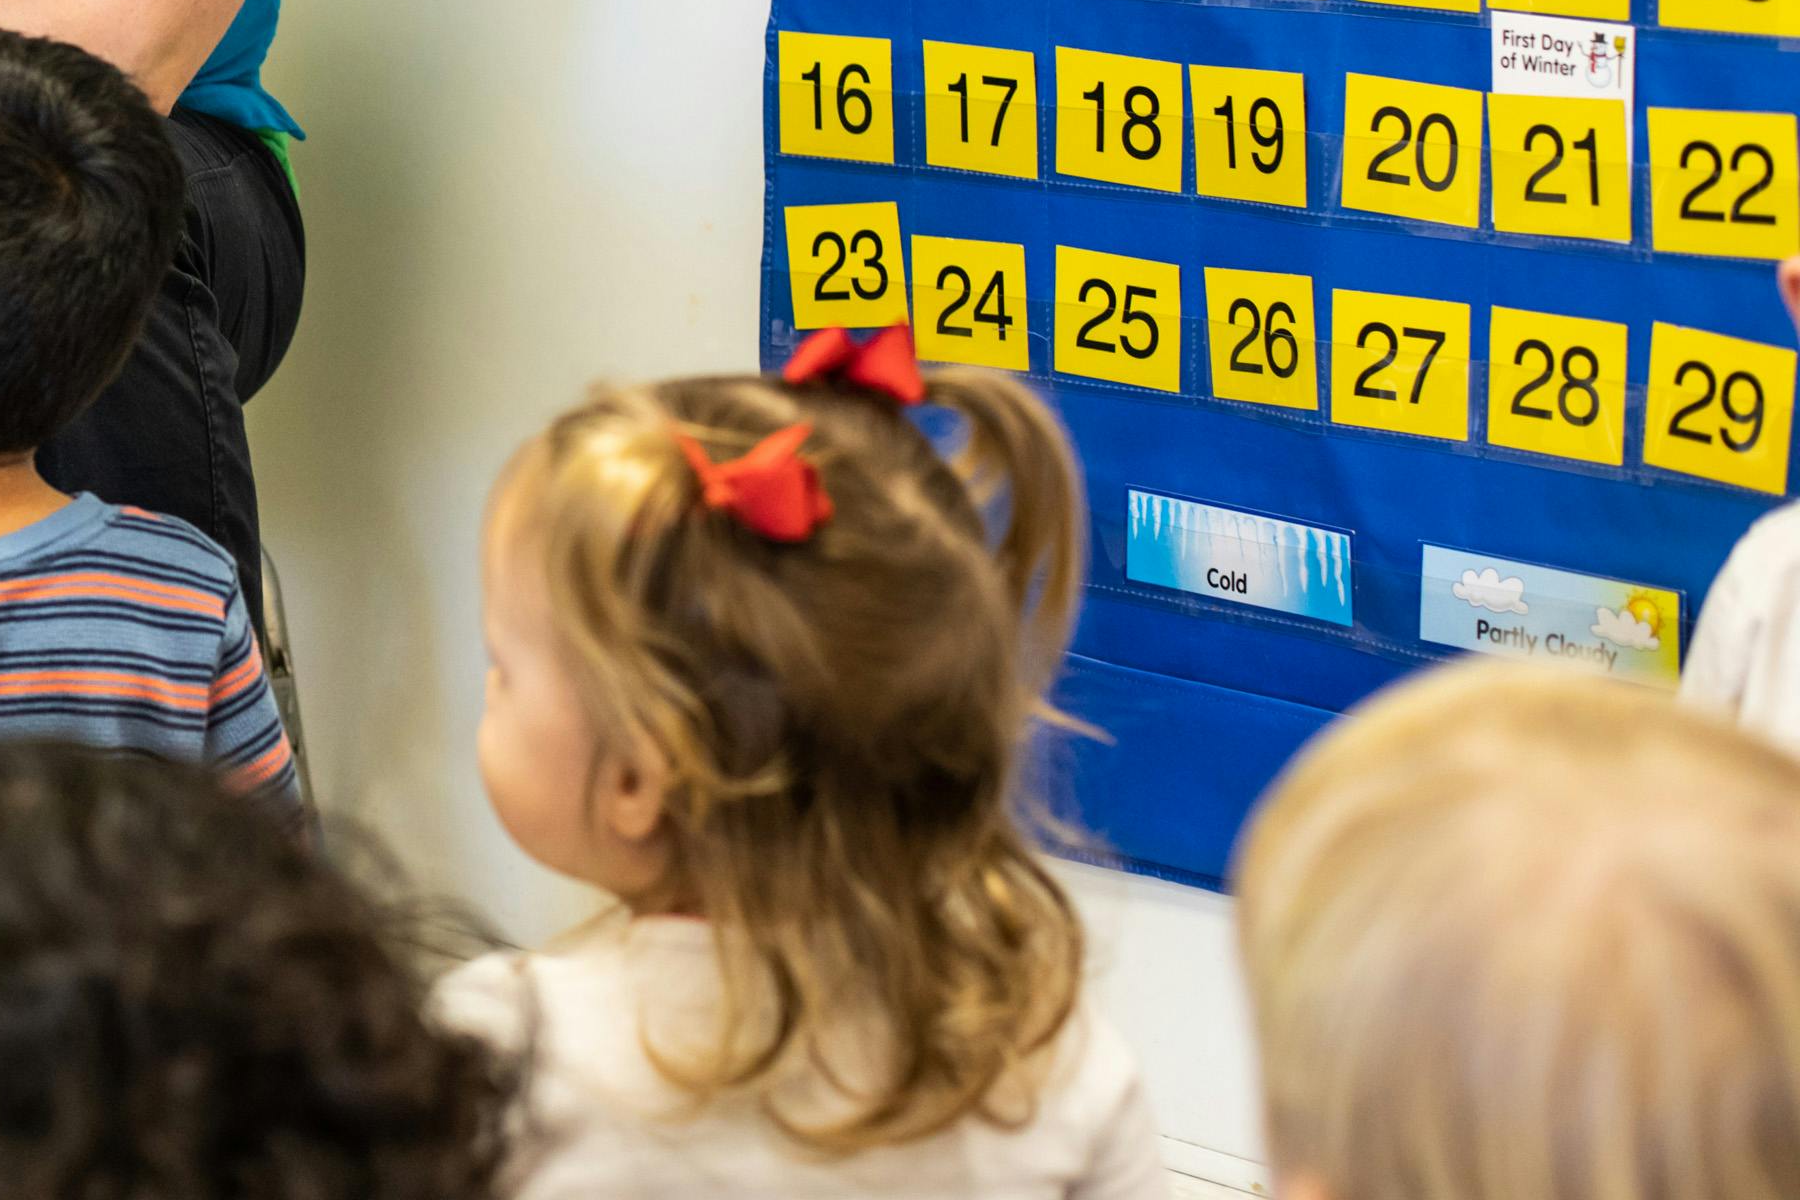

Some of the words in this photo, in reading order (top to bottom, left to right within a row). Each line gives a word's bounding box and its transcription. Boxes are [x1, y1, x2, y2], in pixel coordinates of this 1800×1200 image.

[1500, 51, 1517, 69] of
[1521, 55, 1577, 76] Winter
[1502, 29, 1536, 49] First
[1541, 34, 1574, 57] Day
[801, 61, 873, 135] 16
[947, 72, 1018, 147] 17
[1082, 81, 1162, 161] 18
[1213, 95, 1284, 175] 19
[1366, 105, 1459, 192] 20
[1523, 123, 1600, 207] 21
[1679, 140, 1777, 226] 22
[811, 229, 889, 302] 23
[935, 264, 1014, 342] 24
[1075, 278, 1160, 360] 25
[1228, 297, 1299, 379] 26
[1353, 321, 1446, 405] 27
[1510, 338, 1600, 427] 28
[1668, 360, 1765, 453] 29
[1206, 567, 1248, 594] Cold
[1475, 618, 1538, 656] Partly
[1545, 633, 1619, 672] Cloudy
